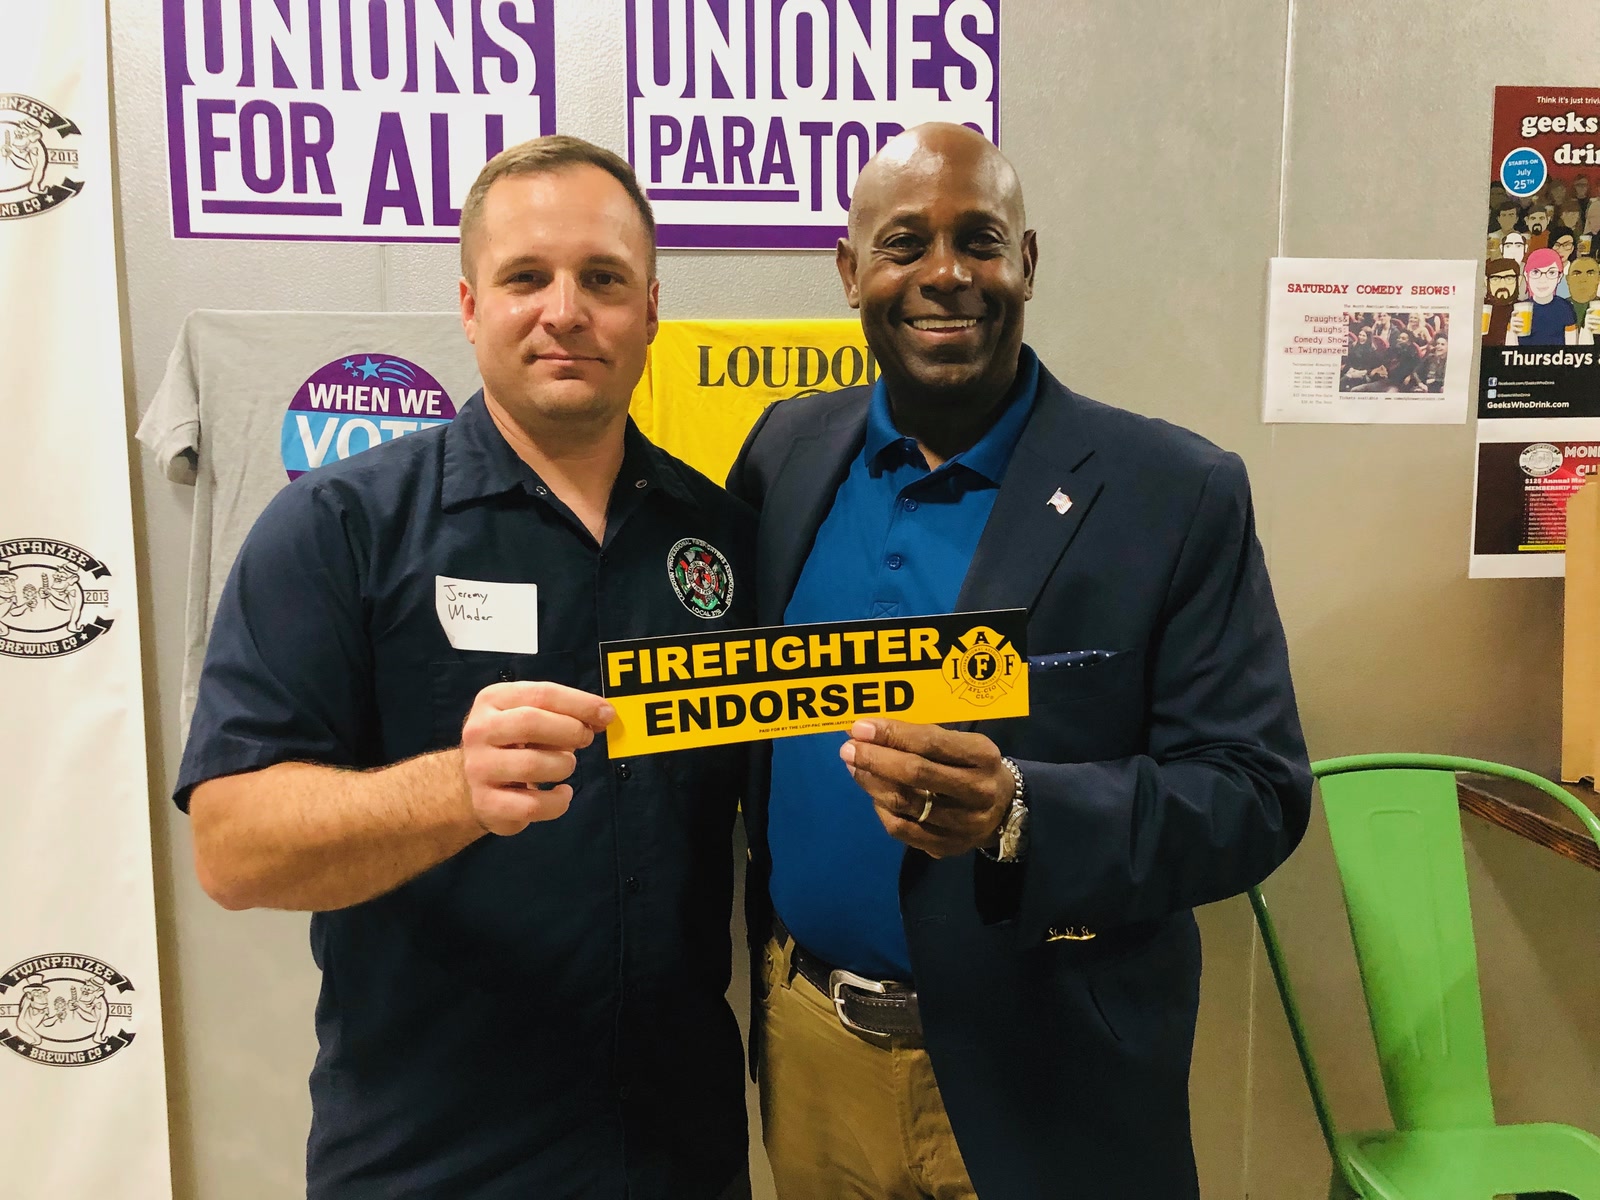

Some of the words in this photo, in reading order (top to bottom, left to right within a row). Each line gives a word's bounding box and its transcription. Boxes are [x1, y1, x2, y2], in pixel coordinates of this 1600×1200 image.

[186, 0, 537, 95] UNIONS
[636, 0, 994, 102] UNIONES
[1536, 96, 1557, 104] Think
[1570, 97, 1584, 105] just
[1521, 111, 1598, 138] geeks
[197, 98, 337, 195] FOR
[649, 115, 796, 184] PARA
[50, 151, 79, 162] 2013
[1516, 168, 1532, 177] July
[1287, 283, 1349, 294] SATURDAY
[1356, 285, 1403, 295] COMEDY
[1411, 286, 1456, 296] SHOWS!
[1294, 336, 1323, 344] Comedy
[1501, 350, 1593, 368] Thursdays
[308, 382, 390, 413] WHEN
[398, 388, 442, 416] WE
[1487, 400, 1570, 409] GeeksWhoDrink.com
[1564, 446, 1600, 458] MON
[85, 591, 109, 602] 2013
[443, 584, 488, 605] Jeremy
[448, 604, 493, 621] Mader
[972, 631, 990, 646] A
[606, 627, 943, 687] FIREFIGHTER
[974, 653, 990, 679] F
[1004, 654, 1016, 676] F
[967, 684, 997, 694] AFL-CIO
[644, 680, 915, 737] ENDORSED
[8, 955, 115, 982] TWINPANZEE
[110, 1005, 133, 1016] 2013
[29, 1047, 86, 1063] BREWING
